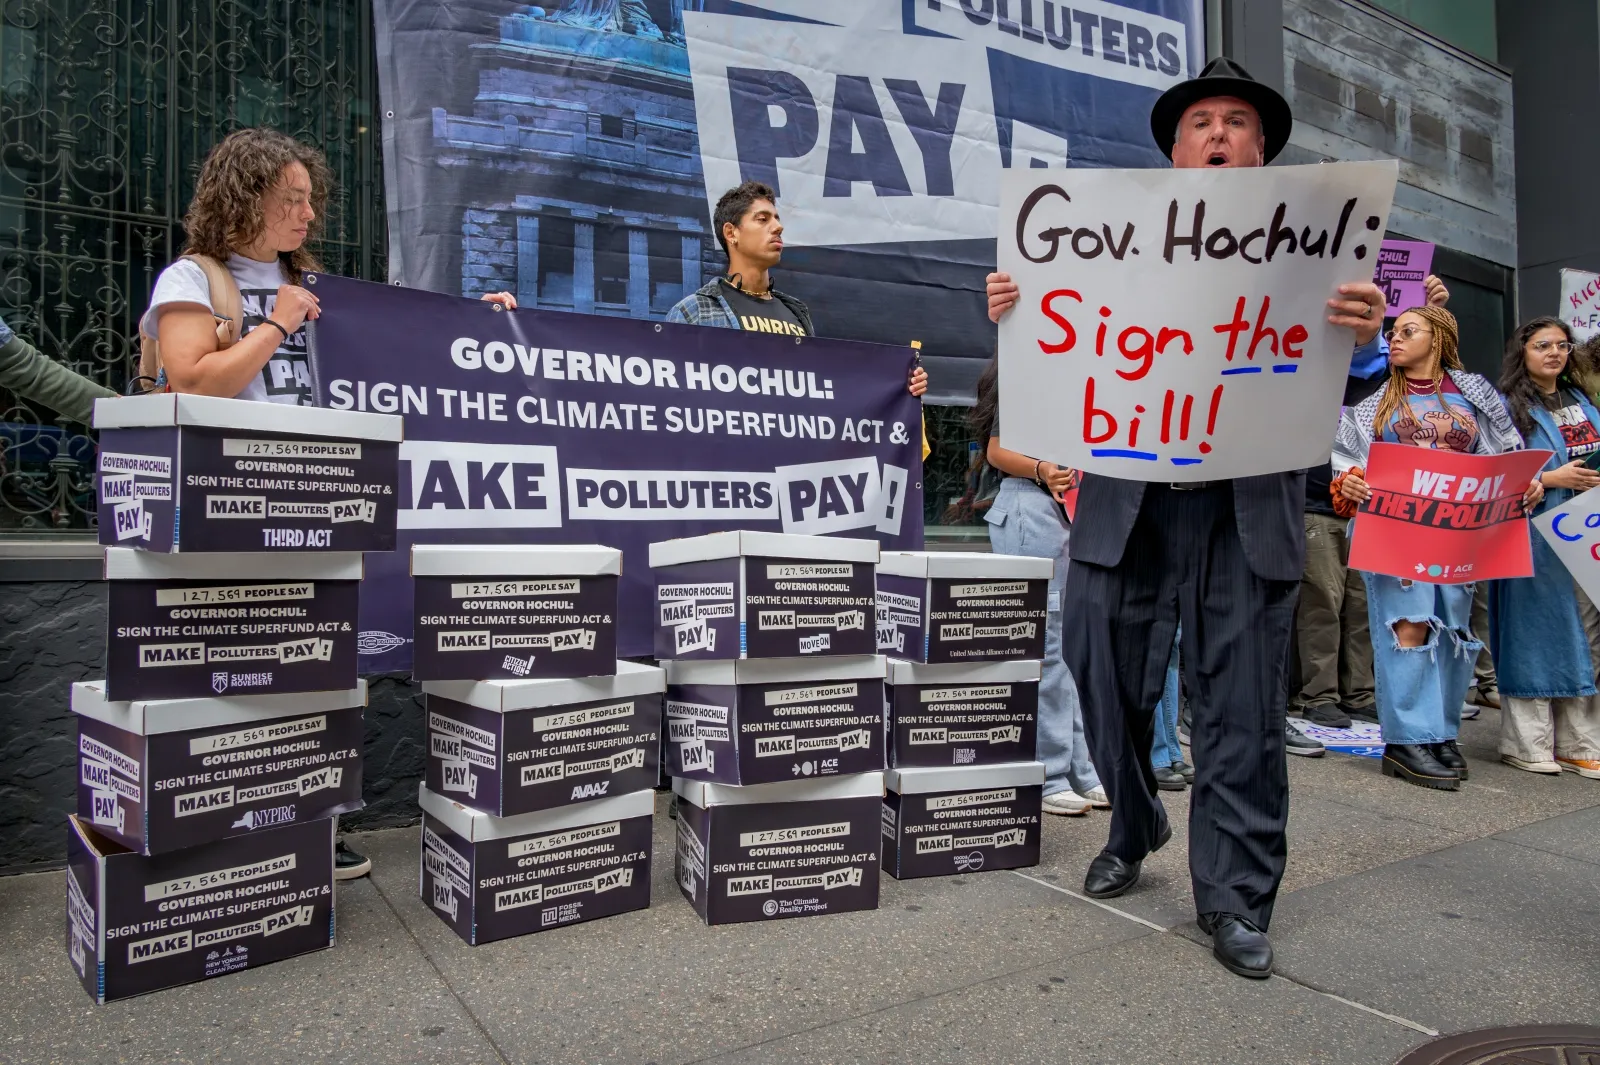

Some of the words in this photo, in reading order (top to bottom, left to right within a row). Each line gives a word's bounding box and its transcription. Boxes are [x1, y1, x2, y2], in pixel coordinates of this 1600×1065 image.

[928, 0, 1182, 77] OLLUTERS
[727, 66, 966, 197] PAY
[1016, 184, 1139, 263] Gov.
[1163, 197, 1380, 264] Hochul:
[1378, 251, 1407, 263] CHUL:
[1384, 271, 1423, 279] POLLUTERS
[741, 315, 805, 336] UNRISE
[1037, 289, 1194, 380] Sign
[1214, 295, 1308, 361] the
[269, 360, 311, 389] PA
[450, 337, 677, 389] GOVERNOR
[686, 361, 834, 399] HOCHUL:
[328, 378, 427, 419] SIGN
[436, 387, 507, 423] THE
[517, 393, 657, 431] CLIMATE
[665, 404, 835, 440] SUPERFUND
[841, 418, 883, 443] ACT
[889, 421, 908, 444] &
[1084, 377, 1224, 454] bill!
[103, 456, 137, 470] GOVERNOR
[139, 460, 168, 473] HOCHUL:
[235, 460, 303, 474] GOVERNOR
[306, 463, 354, 476] HOCHUL:
[104, 480, 132, 497] MAKE
[136, 486, 170, 496] POLLUTERS
[187, 475, 217, 487] SIGN
[220, 477, 243, 488] THE
[246, 478, 295, 490] CLIMATE
[297, 481, 360, 493] SUPERFUND
[362, 484, 381, 494] ACT
[383, 485, 392, 494] &
[400, 459, 547, 511] AKE
[577, 478, 773, 510] POLLUTERS
[1412, 469, 1455, 496] WE
[1455, 474, 1506, 502] PAY.
[211, 500, 262, 514] MAKE
[271, 505, 329, 514] POLLUTERS
[1367, 494, 1435, 522] THEY
[1432, 499, 1522, 528] POLLUTE.
[306, 530, 332, 547] ACT
[1454, 564, 1473, 572] ACE
[245, 588, 285, 597] PEOPLE
[288, 587, 307, 596] SAY
[660, 588, 698, 597] GOVERNOR
[700, 587, 731, 596] HOCHUL:
[775, 582, 817, 591] GOVERNOR
[818, 583, 849, 592] HOCHUL:
[170, 608, 247, 619] GOVERNOR
[250, 608, 306, 617] HOCHUL:
[462, 601, 524, 609] GOVERNOR
[527, 601, 573, 609] HOCHUL:
[663, 605, 693, 621] MAKE
[699, 606, 733, 615] POLLUTERS
[762, 615, 793, 626] MAKE
[943, 627, 970, 637] MAKE
[441, 635, 486, 647] MAKE
[495, 636, 549, 645] POLLUTERS
[144, 648, 200, 663] MAKE
[211, 648, 277, 659] POLLUTERS
[231, 673, 272, 681] SUNRISE
[231, 679, 272, 687] MOVEMENT
[773, 706, 819, 716] GOVERNOR
[820, 704, 853, 713] HOCHUL:
[431, 716, 464, 736] GOVERNOR
[465, 728, 493, 746] HOCHUL:
[542, 728, 591, 742] GOVERNOR
[593, 724, 629, 736] HOCHUL:
[912, 731, 944, 741] MAKE
[202, 747, 270, 766] GOVERNOR
[273, 740, 319, 755] HOCHUL:
[433, 738, 459, 756] MAKE
[463, 750, 494, 766] POLLUTERS
[758, 740, 792, 753] MAKE
[799, 739, 837, 748] POLLUTERS
[524, 765, 561, 781] MAKE
[568, 760, 610, 773] POLLUTERS
[821, 759, 837, 767] ACE
[179, 791, 231, 812] MAKE
[240, 782, 296, 799] POLLUTERS
[571, 781, 609, 800] AVAAZ
[252, 804, 295, 827] NYPIRG
[933, 809, 976, 819] GOVERNOR
[978, 807, 1010, 815] HOCHUL:
[749, 845, 802, 856] GOVERNOR
[804, 843, 843, 852] HOCHUL:
[919, 839, 950, 850] MAKE
[956, 837, 993, 846] POLLUTERS
[518, 850, 571, 867] GOVERNOR
[574, 844, 614, 858] HOCHUL:
[231, 863, 270, 880] PEOPLE
[272, 859, 290, 871] SAY
[731, 879, 769, 893] MAKE
[776, 877, 823, 888] POLLUTERS
[158, 890, 233, 912] GOVERNOR
[236, 880, 288, 898] HOCHUL:
[499, 889, 539, 907] MAKE
[547, 881, 593, 896] POLLUTERS
[559, 902, 583, 911] FOSSIL
[779, 905, 802, 914] Reality
[804, 903, 826, 912] Project
[559, 914, 580, 922] MEDIA
[133, 936, 188, 959] MAKE
[198, 922, 261, 944] POLLUTERS
